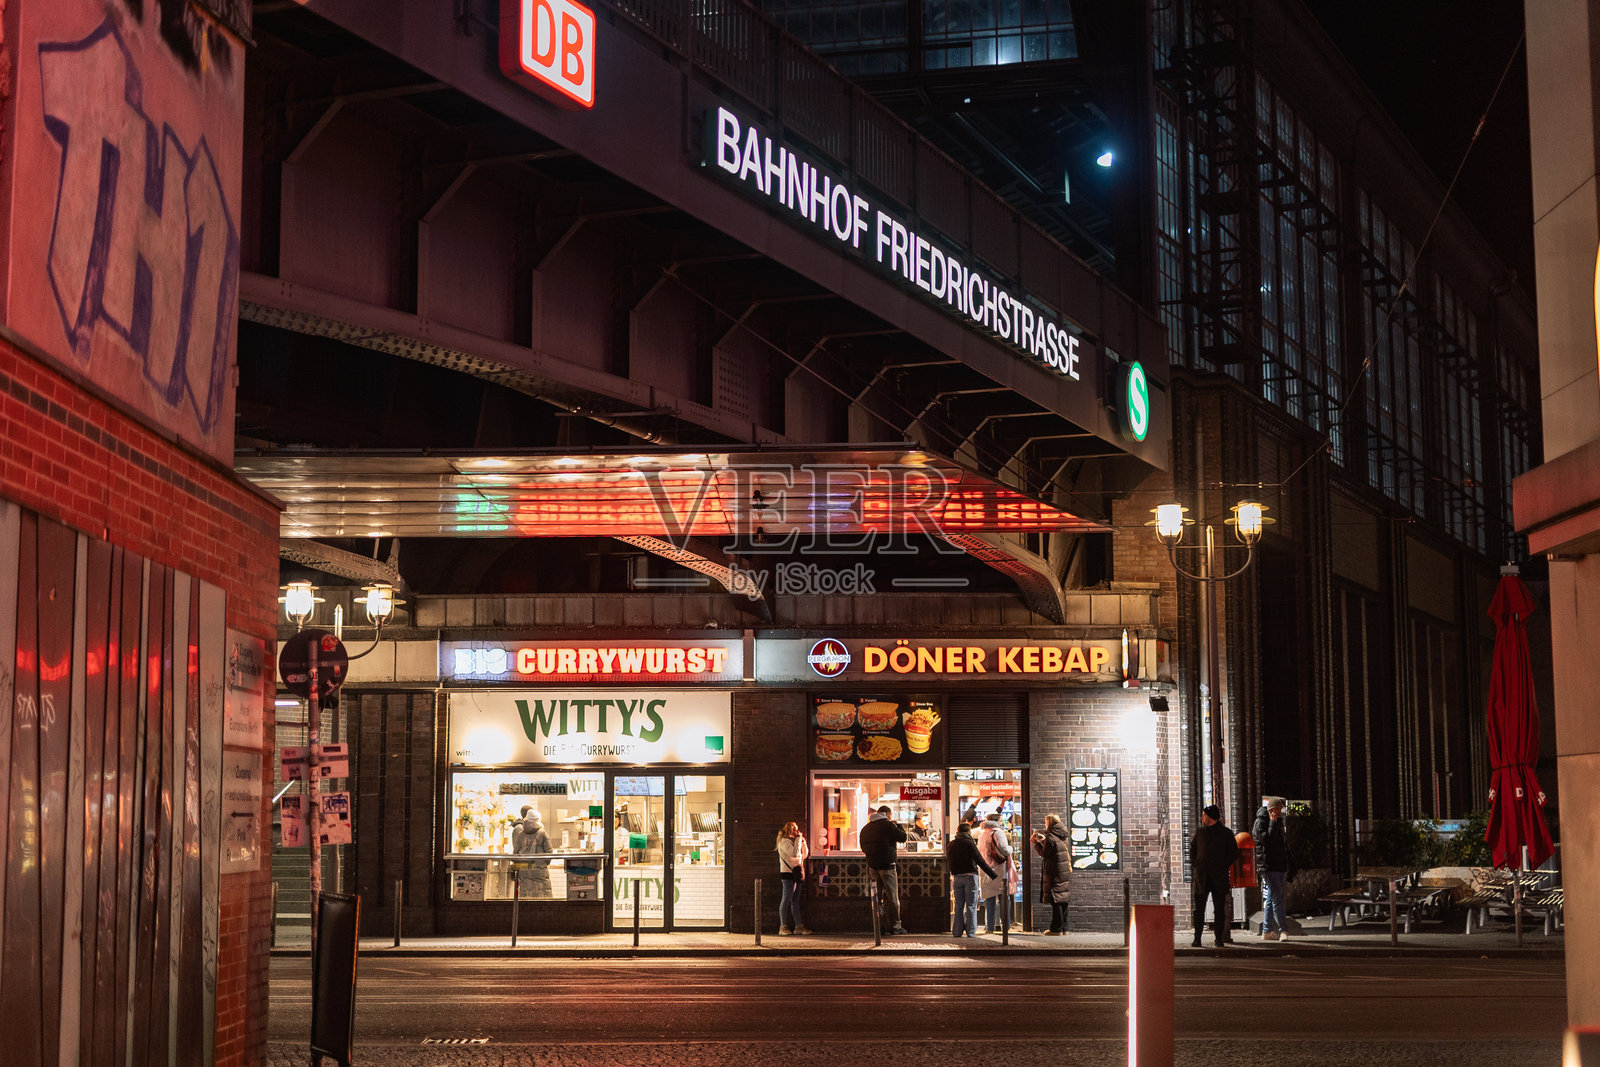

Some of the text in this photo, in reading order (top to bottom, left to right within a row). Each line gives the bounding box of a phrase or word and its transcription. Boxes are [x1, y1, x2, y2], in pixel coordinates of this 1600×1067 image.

[531, 0, 585, 87] DB
[717, 106, 1081, 382] BAHNHOF FRIEDRICHSTRASSE
[1127, 365, 1148, 439] S
[517, 647, 729, 675] CURRYWURST
[808, 655, 850, 663] PERGAMON
[864, 639, 1111, 674] DÖNER KEBAP
[514, 698, 667, 744] WITTY'S
[543, 745, 556, 756] DIE
[511, 782, 566, 794] Glühwein
[903, 787, 938, 797] Ausgabe
